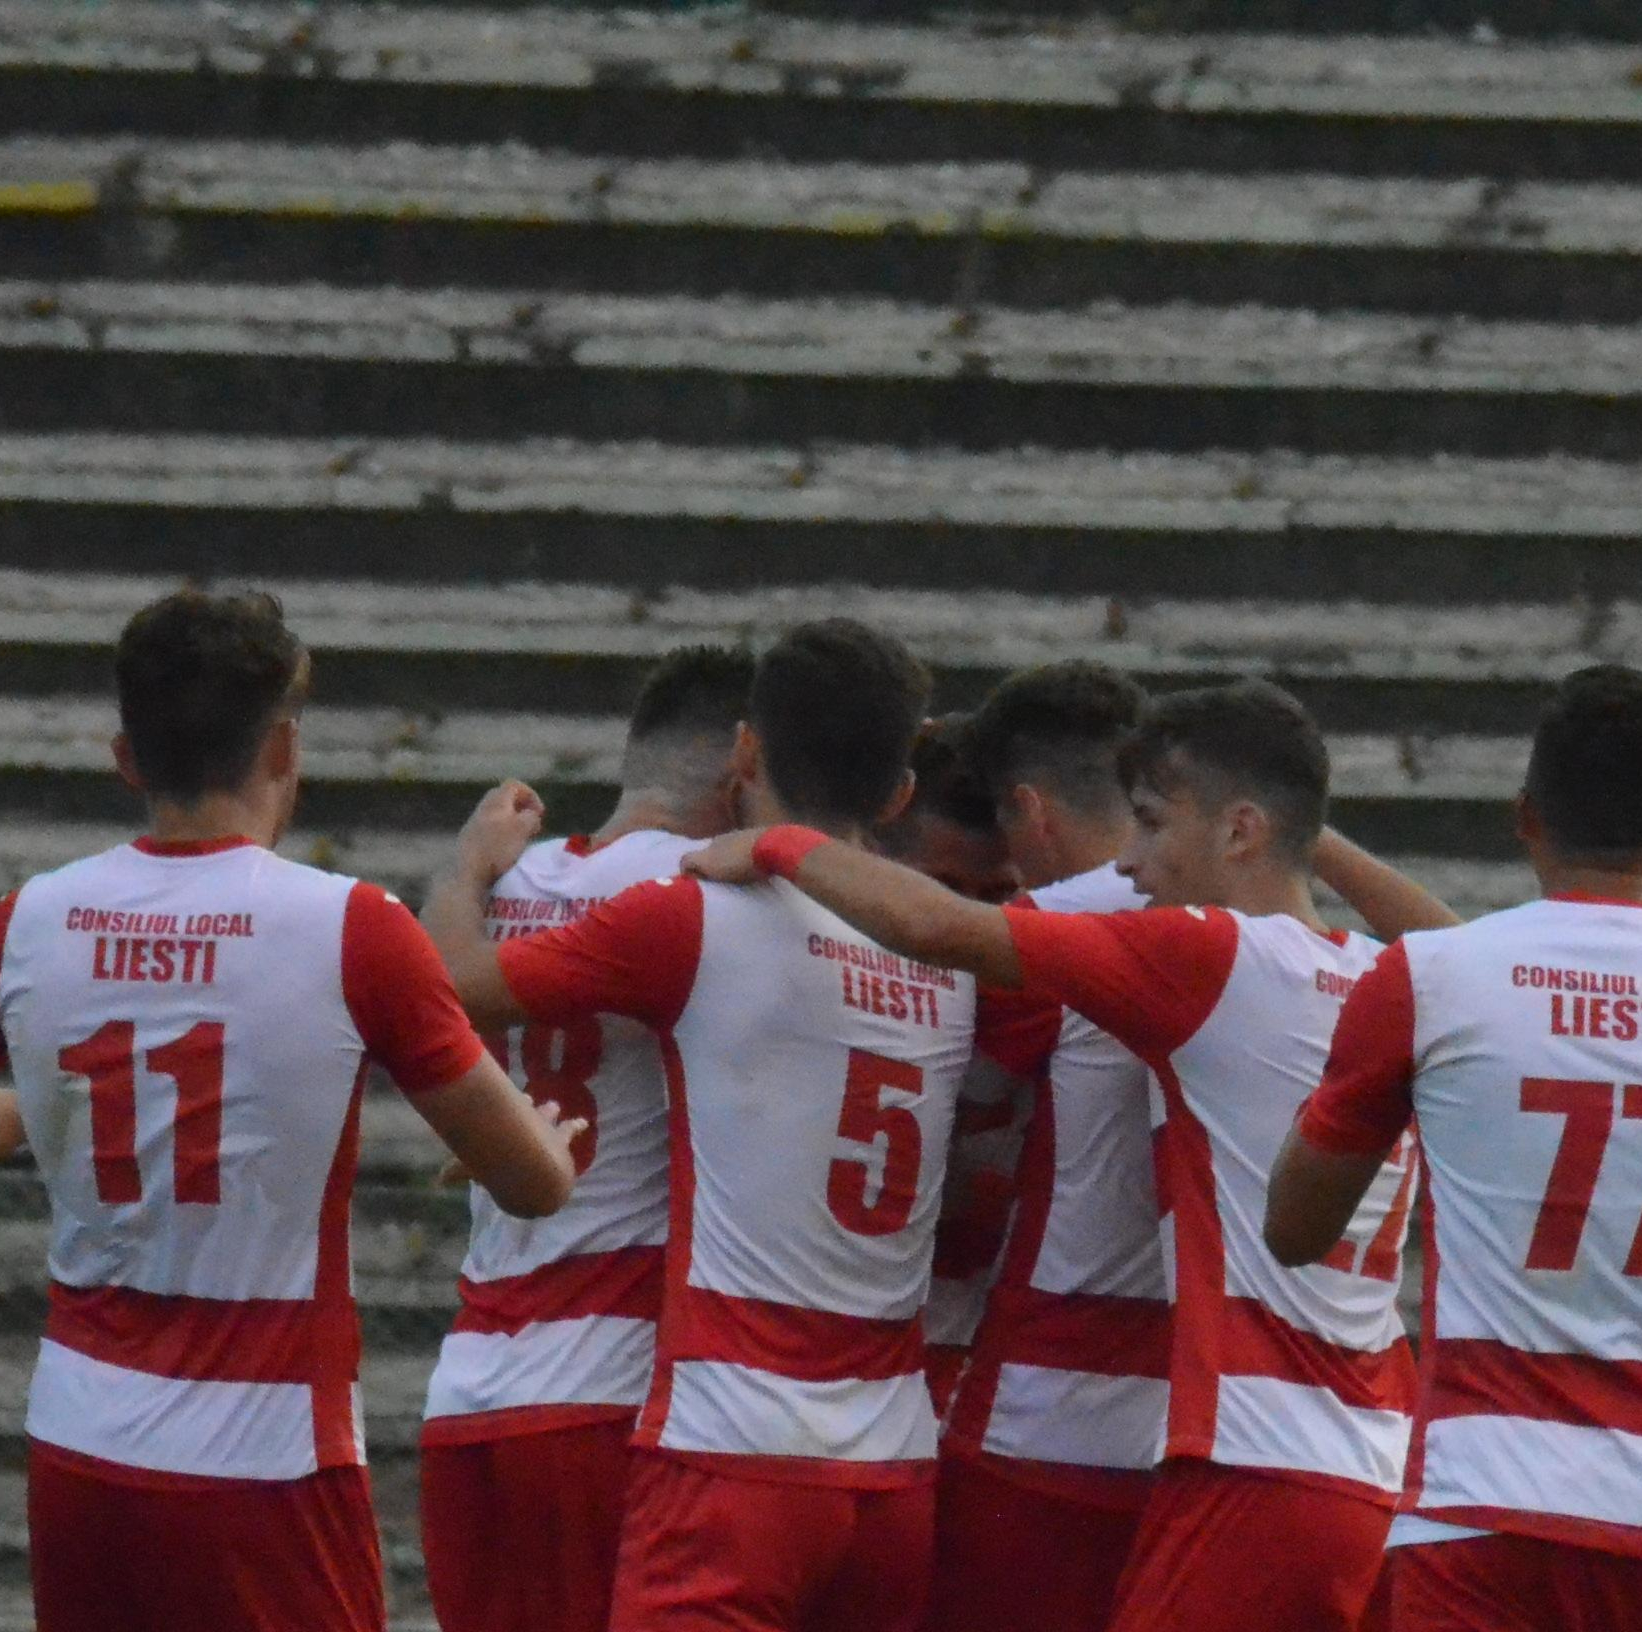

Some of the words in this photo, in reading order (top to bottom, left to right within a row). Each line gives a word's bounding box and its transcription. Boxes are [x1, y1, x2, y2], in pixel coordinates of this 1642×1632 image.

[66, 905, 179, 935] CONSILIUL
[185, 913, 254, 938] LOCAL
[92, 936, 217, 984] LIESTI
[808, 931, 904, 978] CONSILIUL
[842, 965, 939, 1029] LIESTI
[1511, 964, 1640, 996] CONSILIUL
[58, 1019, 225, 1205] 11
[825, 1047, 924, 1236] 5
